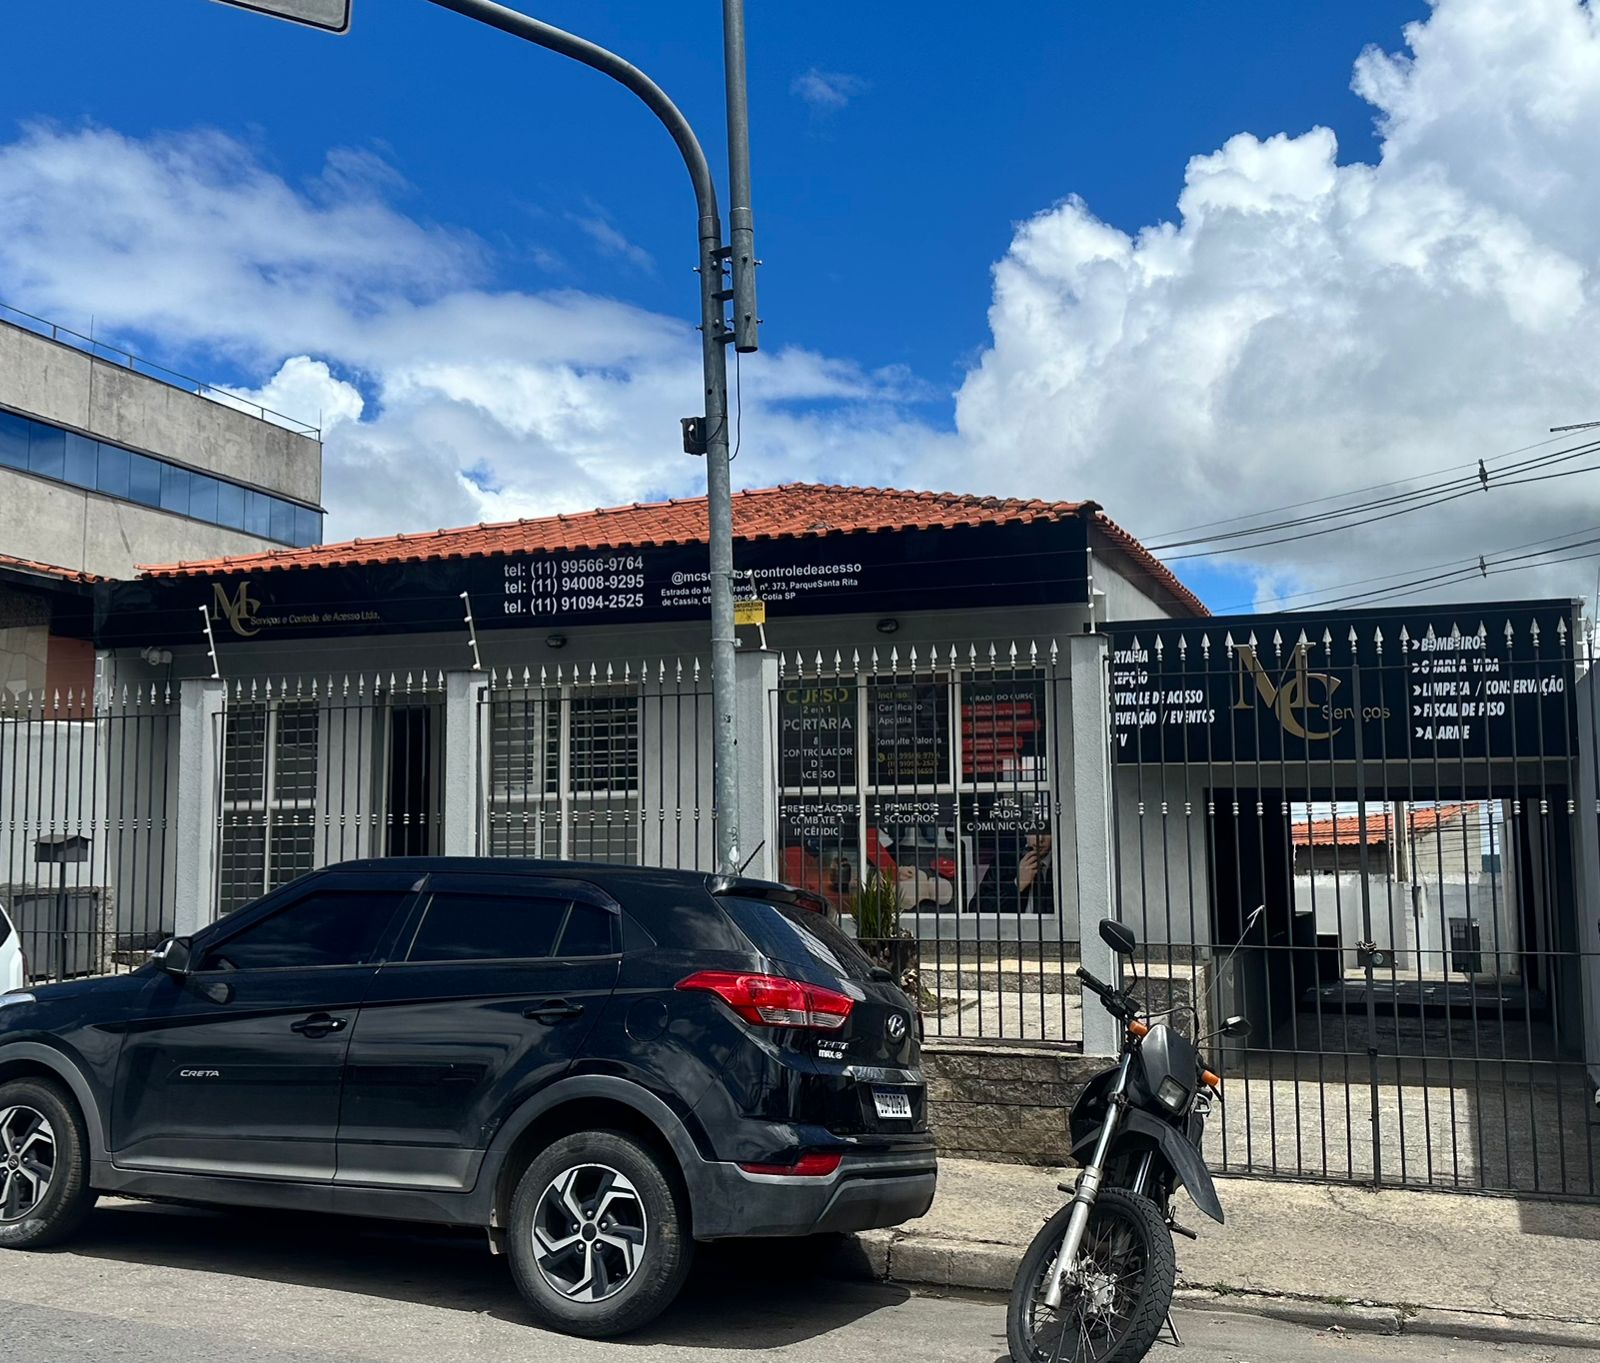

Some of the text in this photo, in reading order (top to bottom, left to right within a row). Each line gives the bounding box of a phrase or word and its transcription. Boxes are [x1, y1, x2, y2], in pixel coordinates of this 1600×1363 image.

[504, 556, 644, 578] tel: (11) 99566-9764
[505, 574, 644, 596] tel: (11) 94008-9295
[661, 588, 689, 597] Estrada
[772, 582, 788, 591] 373,
[842, 578, 858, 586] Rita
[785, 592, 796, 600] SP
[504, 594, 644, 616] tel. (11) 91094-2525
[322, 613, 332, 622] de
[332, 612, 360, 621] Acesso
[1321, 704, 1391, 722] Servços
[1462, 702, 1476, 716] DE
[1424, 725, 1470, 739] AARME
[180, 1069, 219, 1077] CRETA
